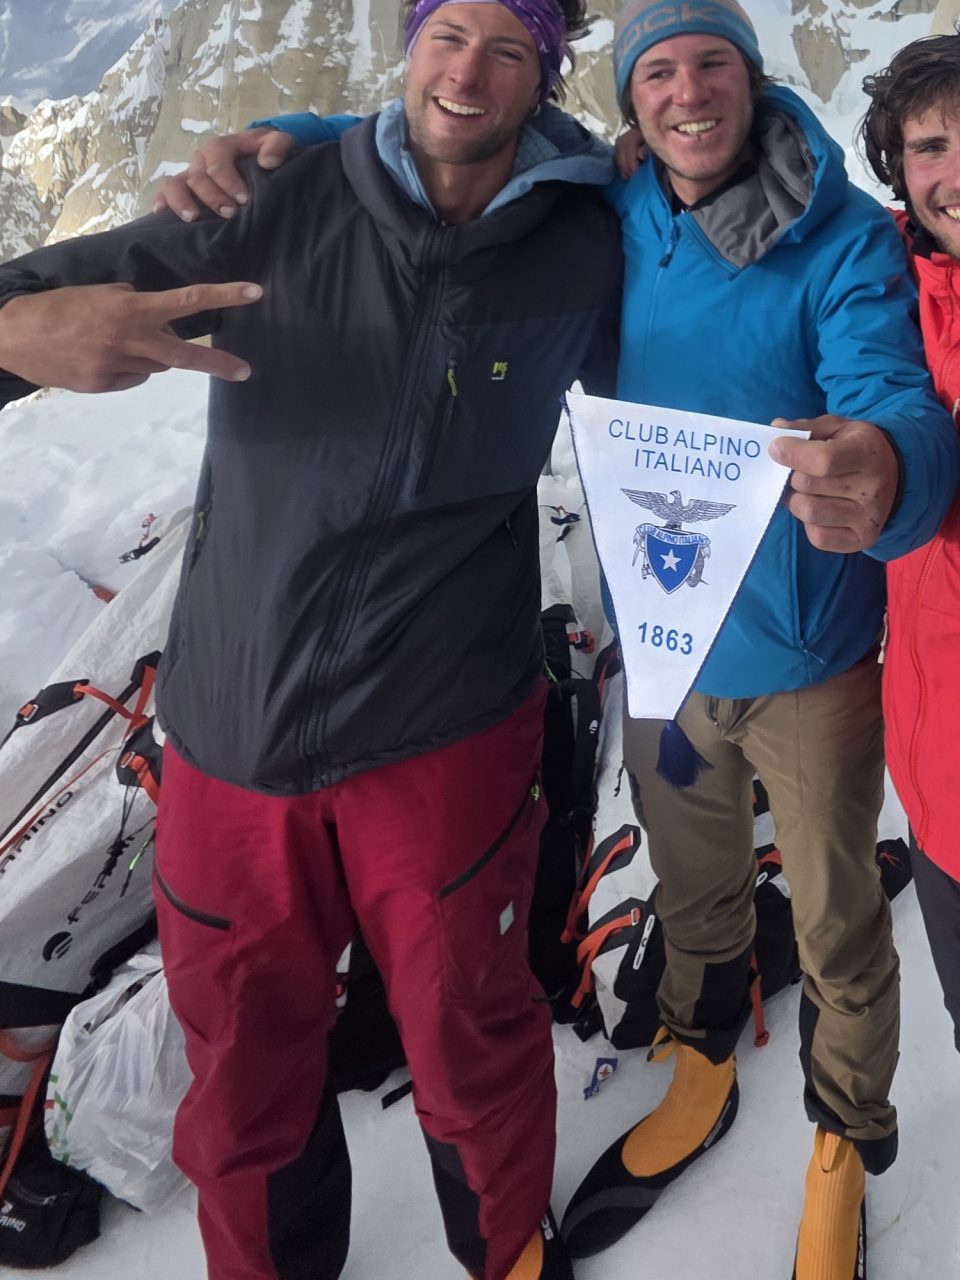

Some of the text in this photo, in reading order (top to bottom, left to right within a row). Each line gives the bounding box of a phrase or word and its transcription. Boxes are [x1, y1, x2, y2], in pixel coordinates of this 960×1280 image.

[608, 418, 762, 459] CLUB ALPINO
[634, 448, 741, 482] ITALIANO
[638, 622, 693, 655] 1863
